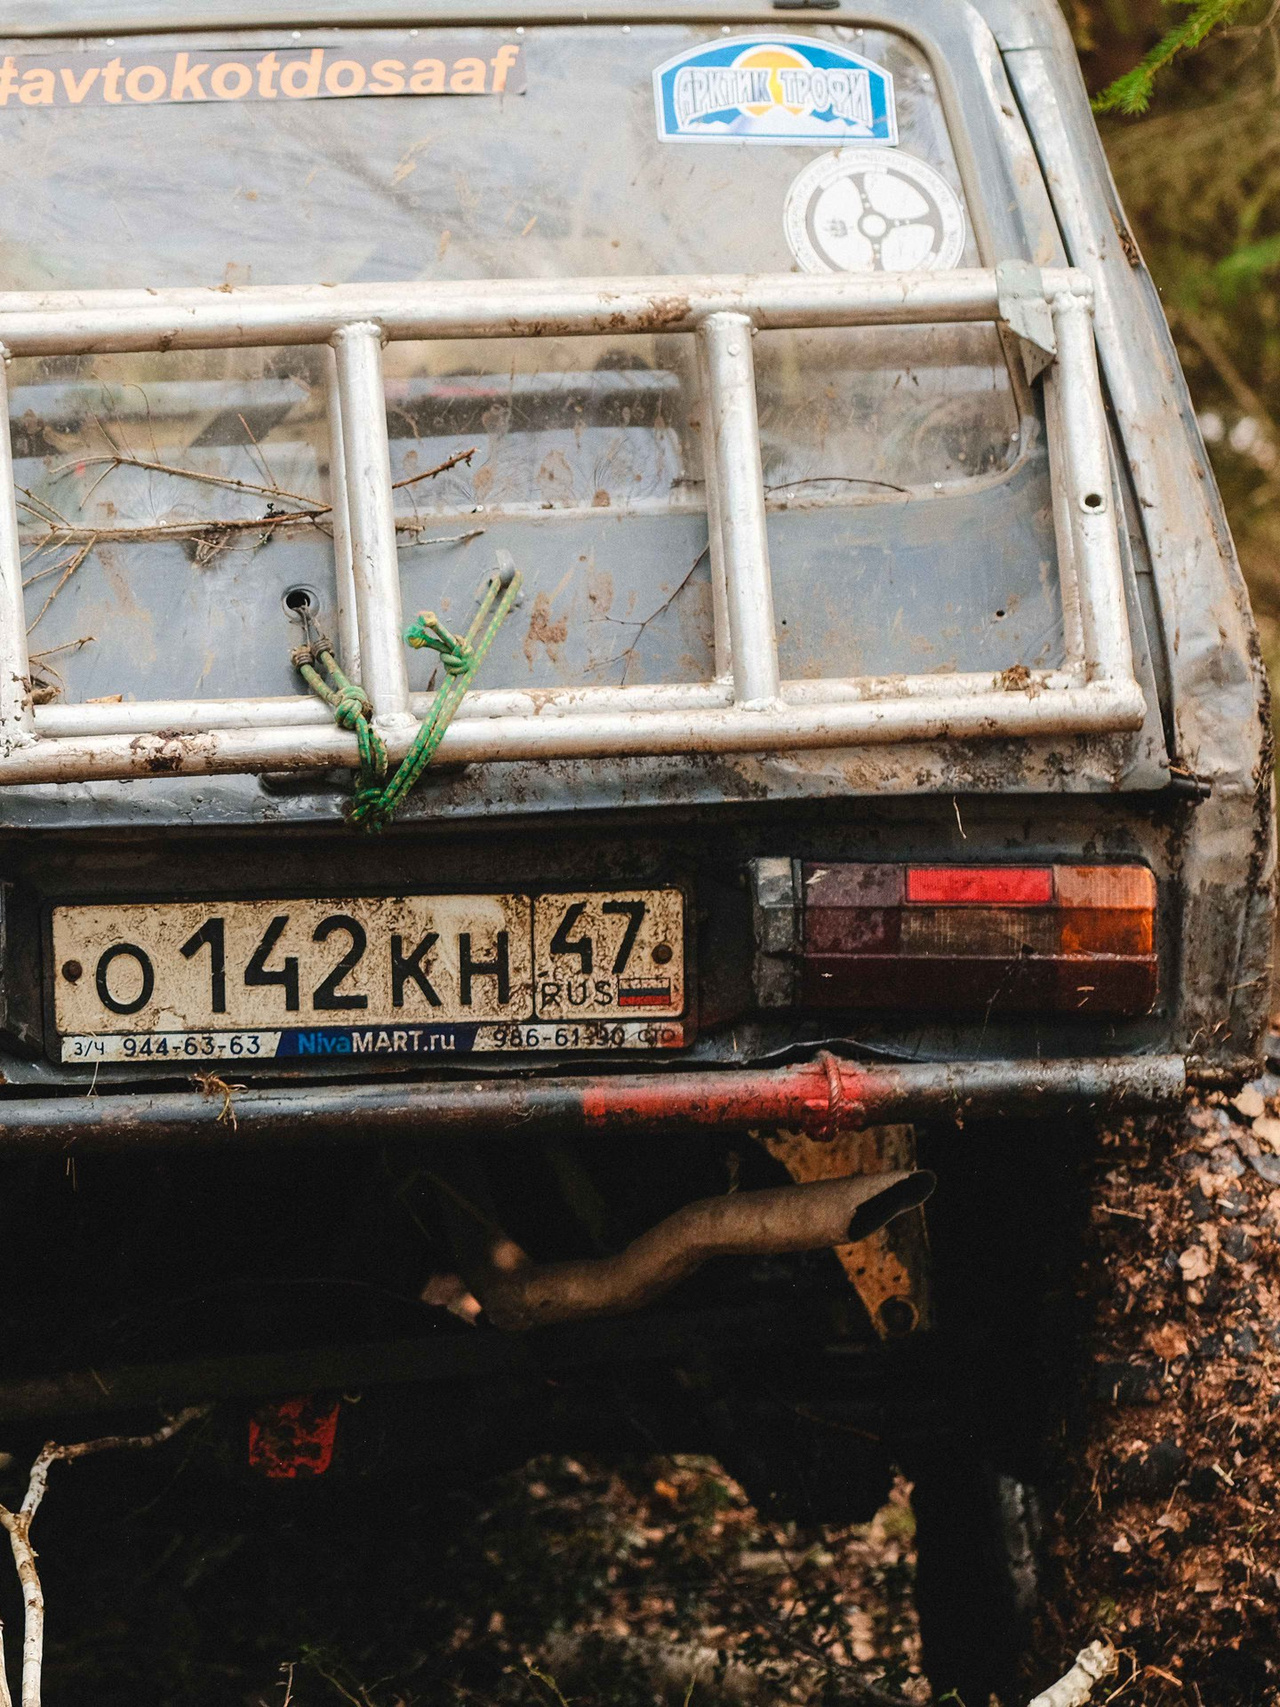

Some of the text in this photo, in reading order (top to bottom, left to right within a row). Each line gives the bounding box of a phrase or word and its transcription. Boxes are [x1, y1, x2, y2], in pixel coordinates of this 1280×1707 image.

[550, 900, 647, 976] 47
[541, 979, 614, 1010] RUS
[123, 1035, 261, 1057] 944-63-63
[297, 1030, 456, 1055] NivaMART.ru
